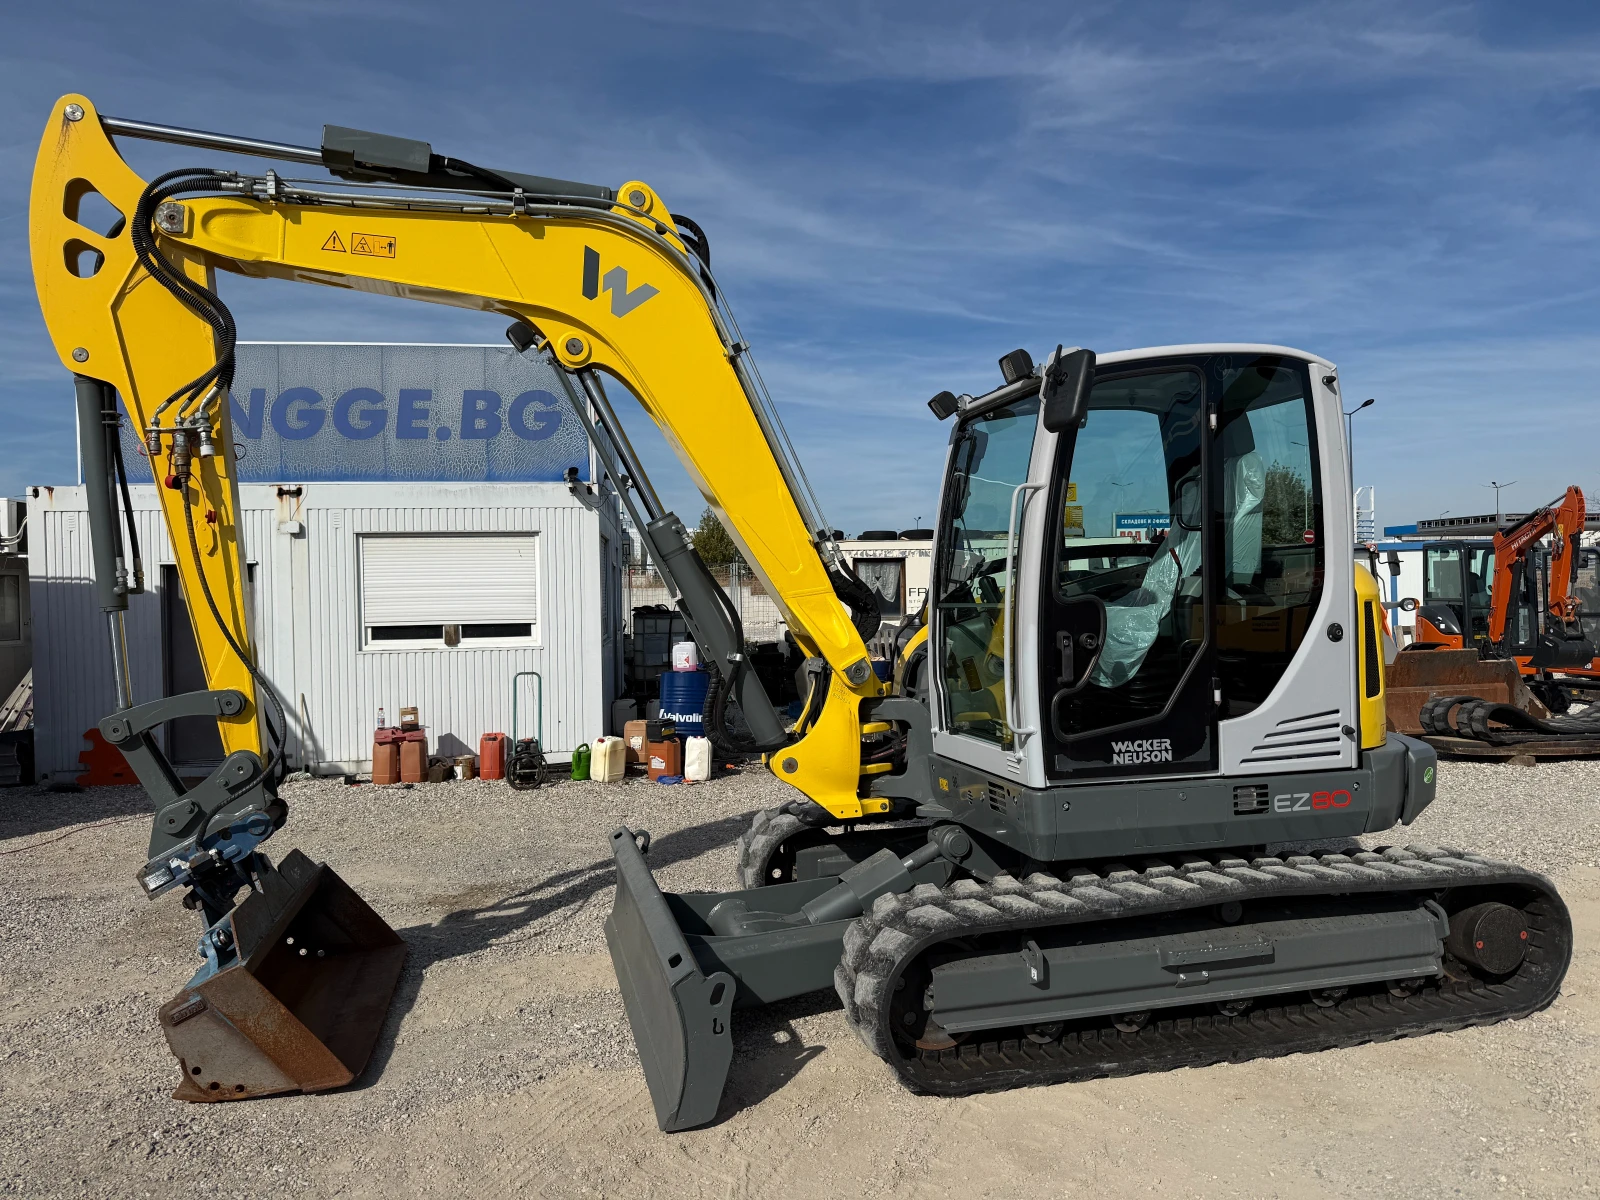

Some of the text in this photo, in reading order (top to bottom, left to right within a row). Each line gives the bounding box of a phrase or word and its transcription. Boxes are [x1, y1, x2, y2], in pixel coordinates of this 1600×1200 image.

[229, 387, 563, 442] NGGE.BG
[1111, 739, 1172, 753] WACKER
[1113, 750, 1173, 765] NEUSON
[1274, 789, 1352, 813] EZ80
